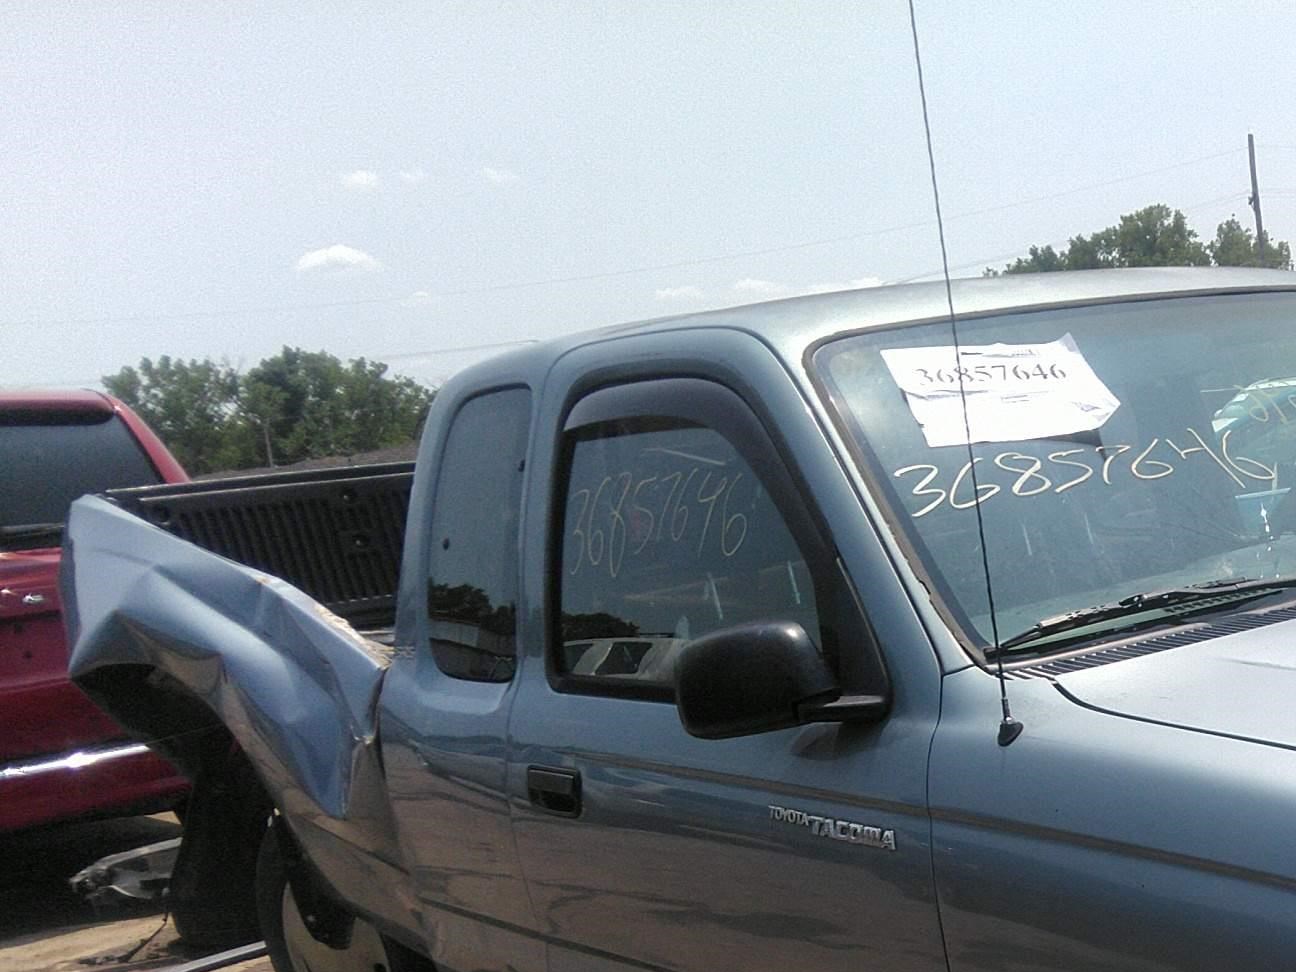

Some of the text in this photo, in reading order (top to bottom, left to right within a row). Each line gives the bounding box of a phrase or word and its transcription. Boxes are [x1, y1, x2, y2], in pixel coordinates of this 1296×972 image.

[914, 363, 1067, 386] 36857646
[895, 428, 1278, 518] 36857646
[570, 467, 748, 578] 36857646
[768, 805, 897, 850] TOYOTA TACOMA
